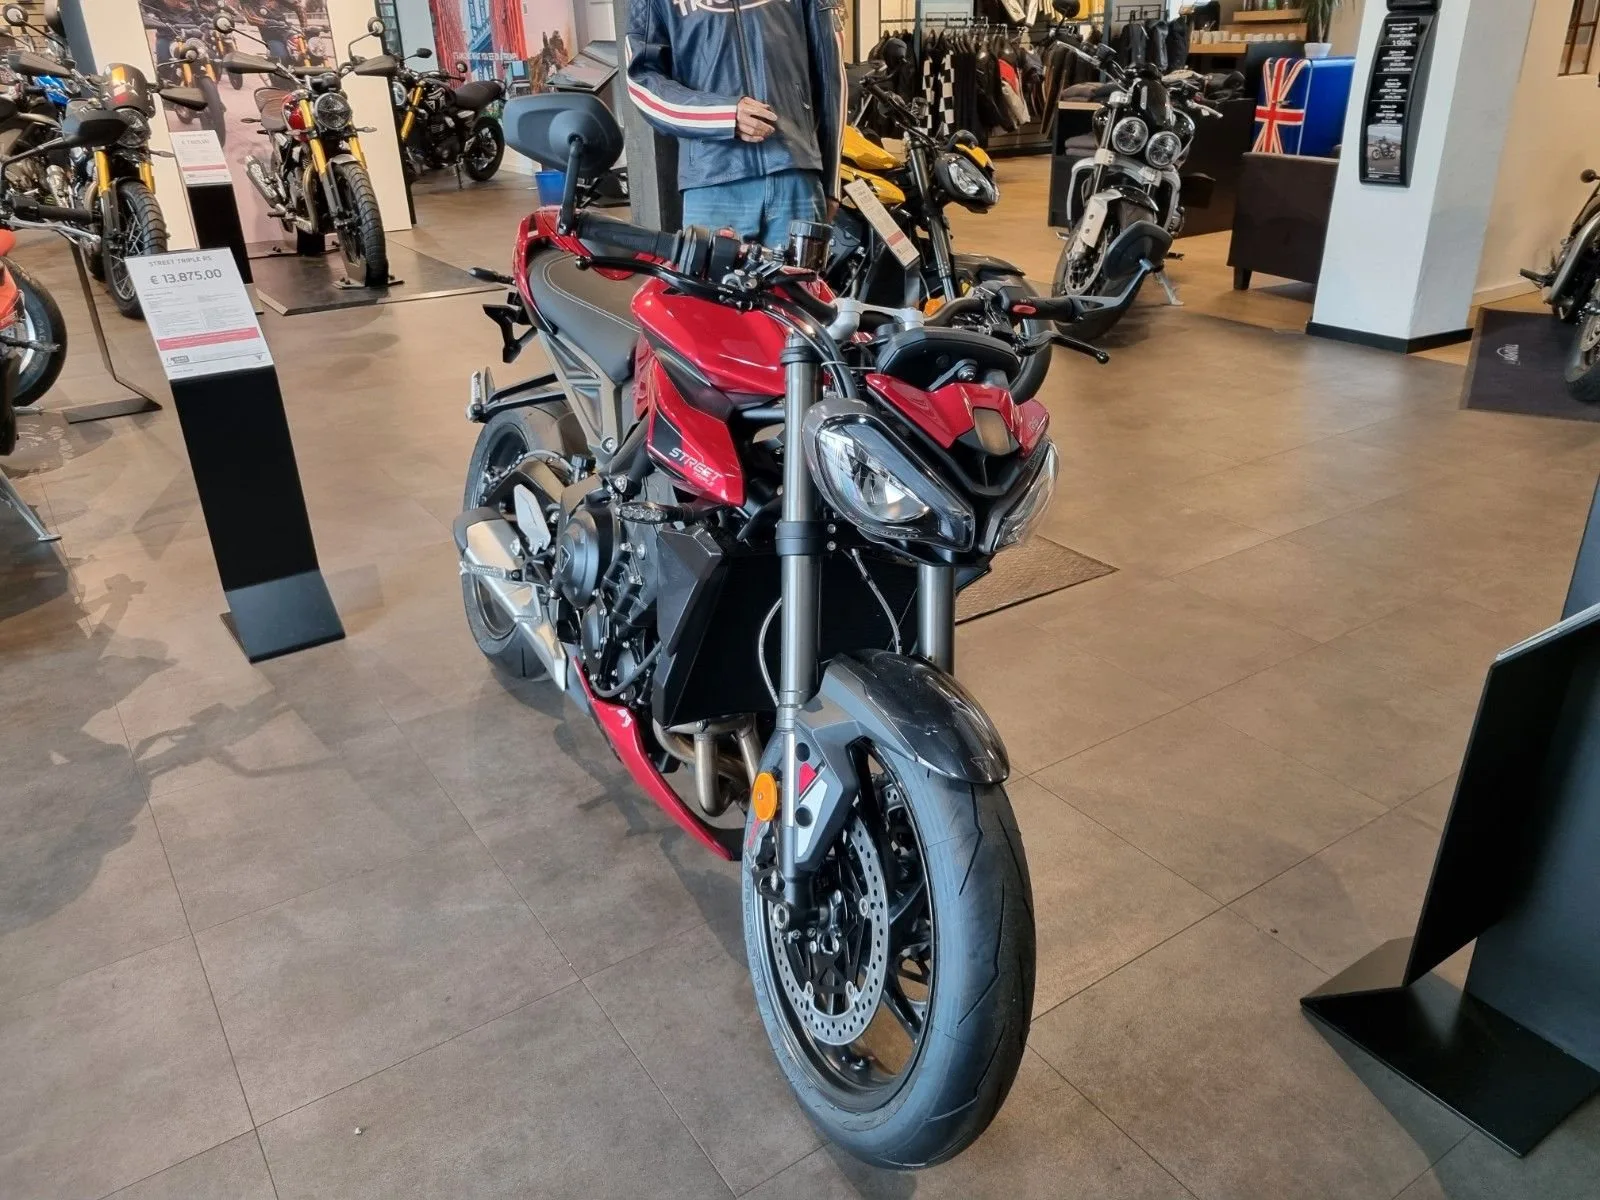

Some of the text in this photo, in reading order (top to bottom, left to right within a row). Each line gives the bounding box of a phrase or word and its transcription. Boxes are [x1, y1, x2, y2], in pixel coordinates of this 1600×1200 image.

[148, 259, 174, 267] STREET
[177, 256, 201, 264] TRIPLE
[150, 268, 222, 284] € 13.875,00
[668, 446, 725, 482] STREET
